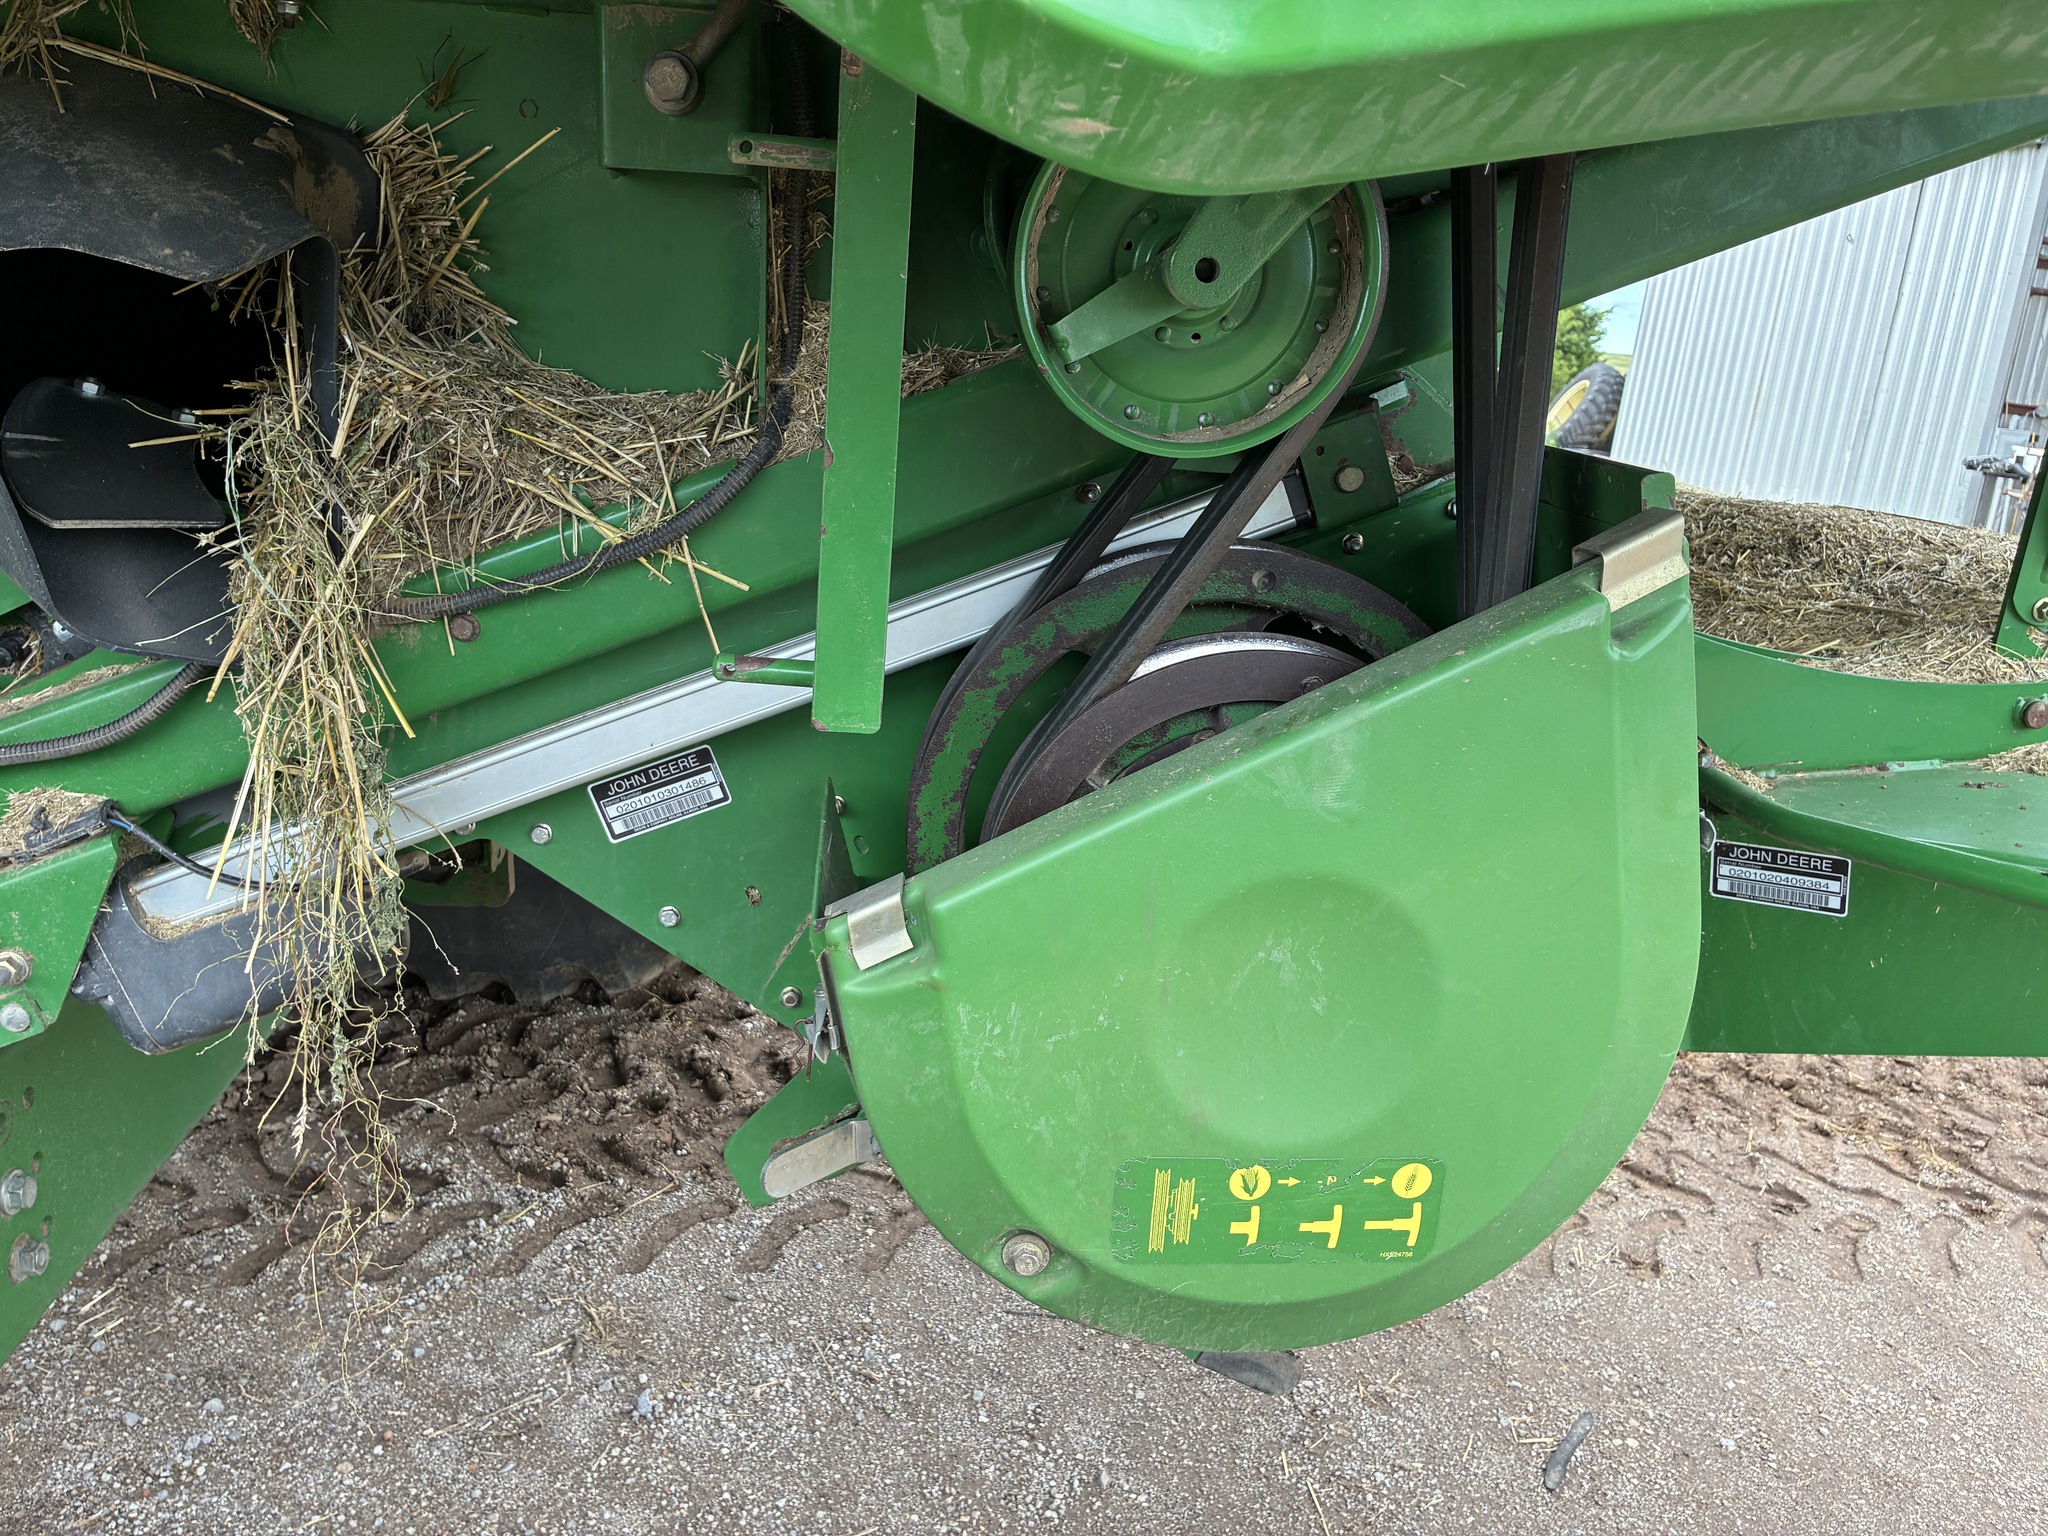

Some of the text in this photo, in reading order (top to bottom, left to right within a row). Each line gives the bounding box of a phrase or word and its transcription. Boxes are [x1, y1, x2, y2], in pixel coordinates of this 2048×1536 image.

[607, 773, 647, 795] JOHN
[649, 754, 700, 780] DEERE
[604, 790, 642, 807] Serial Number
[616, 777, 707, 814] 0201010301486
[1729, 847, 1833, 872] JOHN DEERE
[1738, 861, 1762, 870] Number
[1728, 868, 1830, 891] 0201020409384
